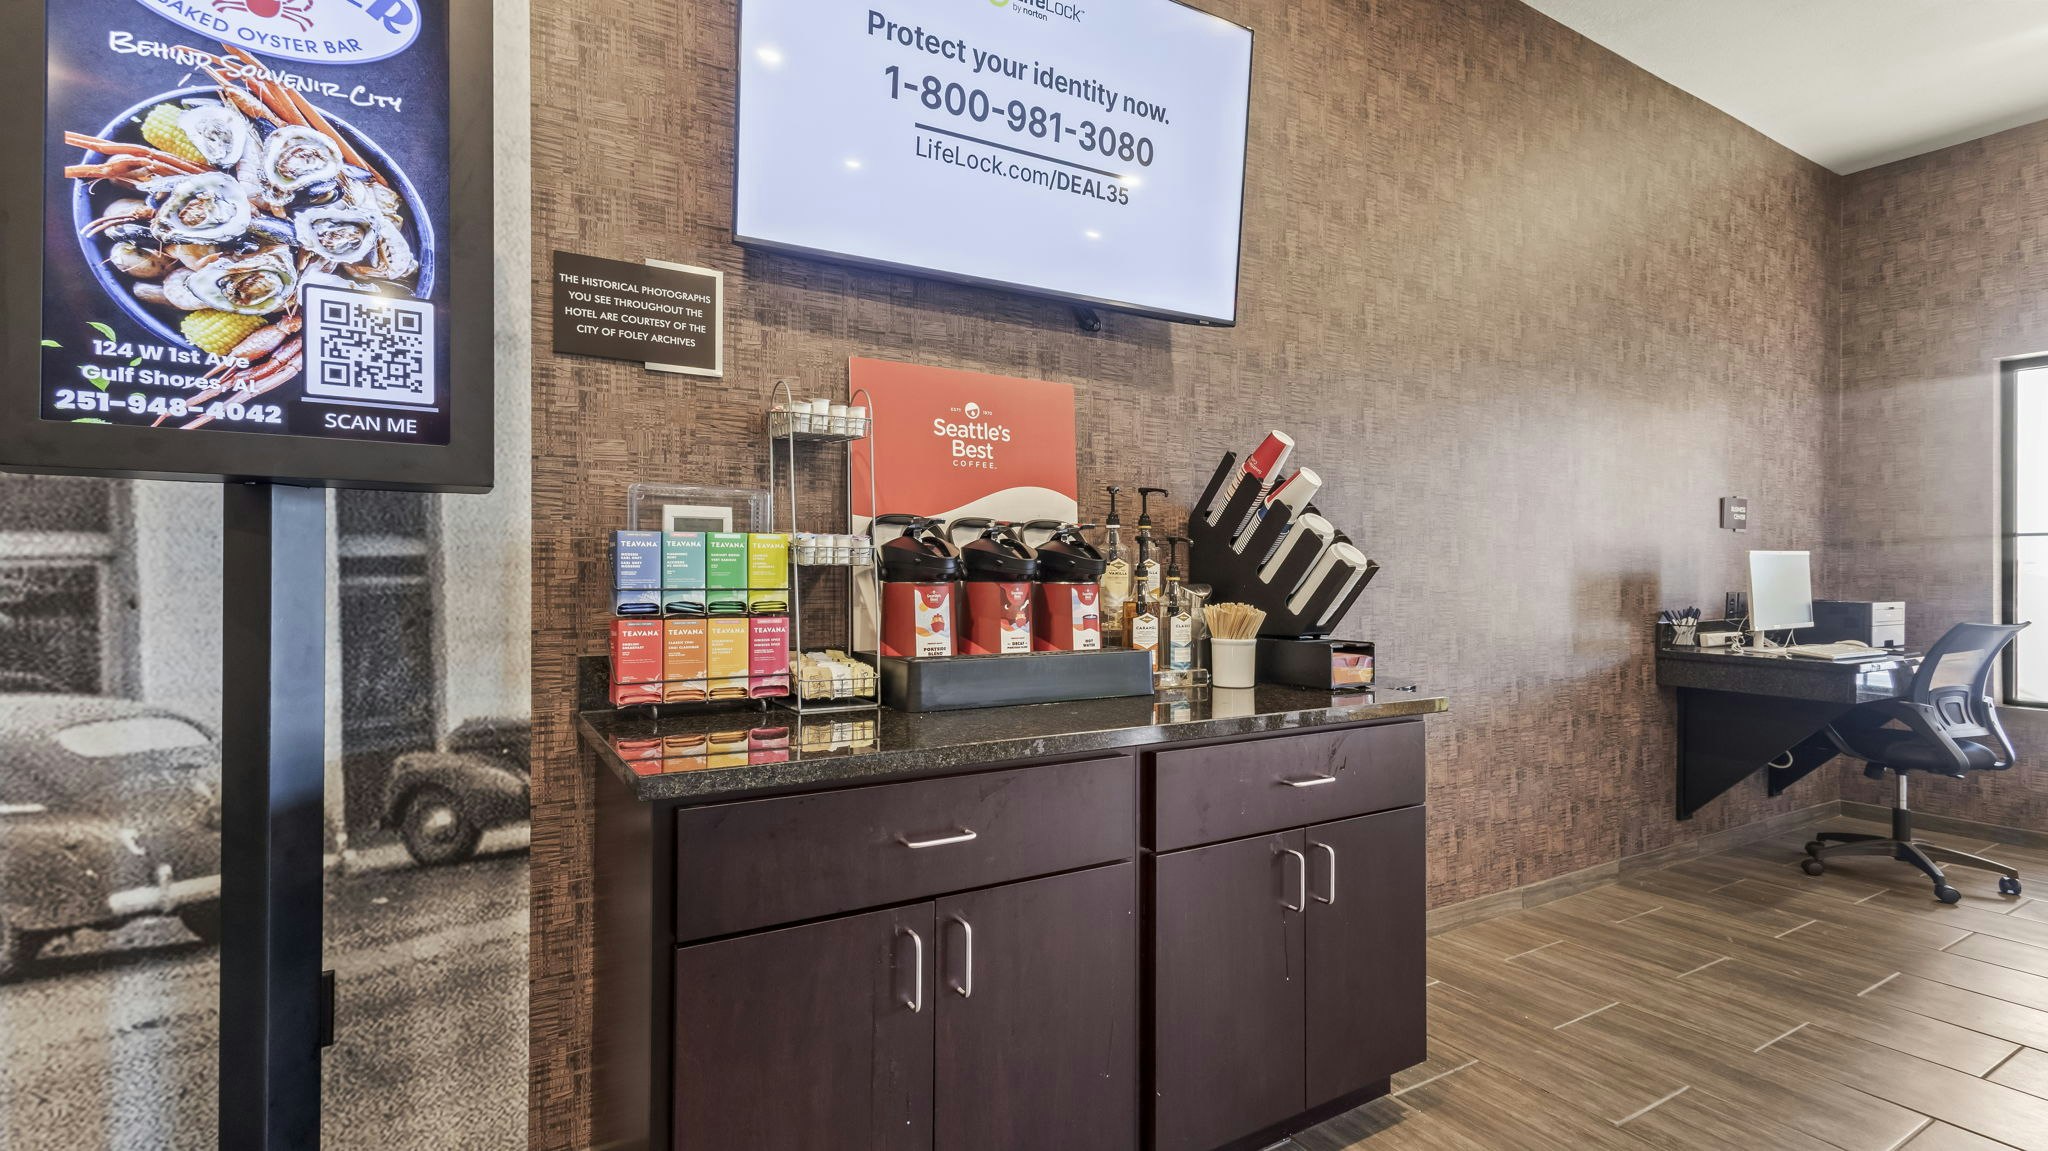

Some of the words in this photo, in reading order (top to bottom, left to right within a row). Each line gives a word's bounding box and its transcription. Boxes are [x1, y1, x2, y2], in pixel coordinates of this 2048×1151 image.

[1012, 3, 1021, 14] by
[1023, 8, 1048, 21] norton
[157, 0, 229, 32] AKED
[238, 27, 318, 54] OYSTER
[324, 38, 363, 55] BAR
[109, 30, 212, 68] BEHIND
[216, 54, 347, 98] SOUVENIR
[349, 85, 402, 112] CITY
[868, 9, 966, 63] Protect
[972, 48, 1028, 80] your
[1033, 61, 1118, 113] identity
[1123, 95, 1170, 125] now.
[885, 65, 1154, 167] 1-800-981-3080
[916, 136, 1129, 205] LifeLock.com/DEAL35
[559, 273, 579, 284] THE
[582, 277, 639, 293] HISTORICAL
[642, 286, 711, 304] PHOTOGRAPHS
[568, 291, 591, 302] YOU
[594, 294, 611, 305] SEE
[614, 298, 683, 315] THROUGHOUT
[686, 308, 703, 318] THE
[565, 307, 597, 319] HOTEL
[600, 312, 618, 322] ARE
[621, 314, 670, 329] COURTESY
[673, 322, 687, 331] OF
[689, 324, 706, 334] THE
[576, 324, 599, 335] CITY
[601, 327, 616, 337] OF
[619, 329, 649, 342] FOLEY
[651, 334, 696, 348] ARCHIVES
[93, 339, 134, 358] 124
[138, 344, 165, 361] W
[169, 345, 201, 365] 1st
[205, 352, 250, 369] Ave
[81, 364, 135, 383] Gulf
[138, 368, 227, 393] Shores,
[232, 380, 260, 393] AL
[54, 389, 282, 424] 251-948-4042
[325, 413, 380, 431] SCAN
[387, 417, 417, 434] ME
[933, 418, 1011, 442] Seattle's
[952, 439, 993, 460] Best
[711, 541, 745, 549] TEAVANA
